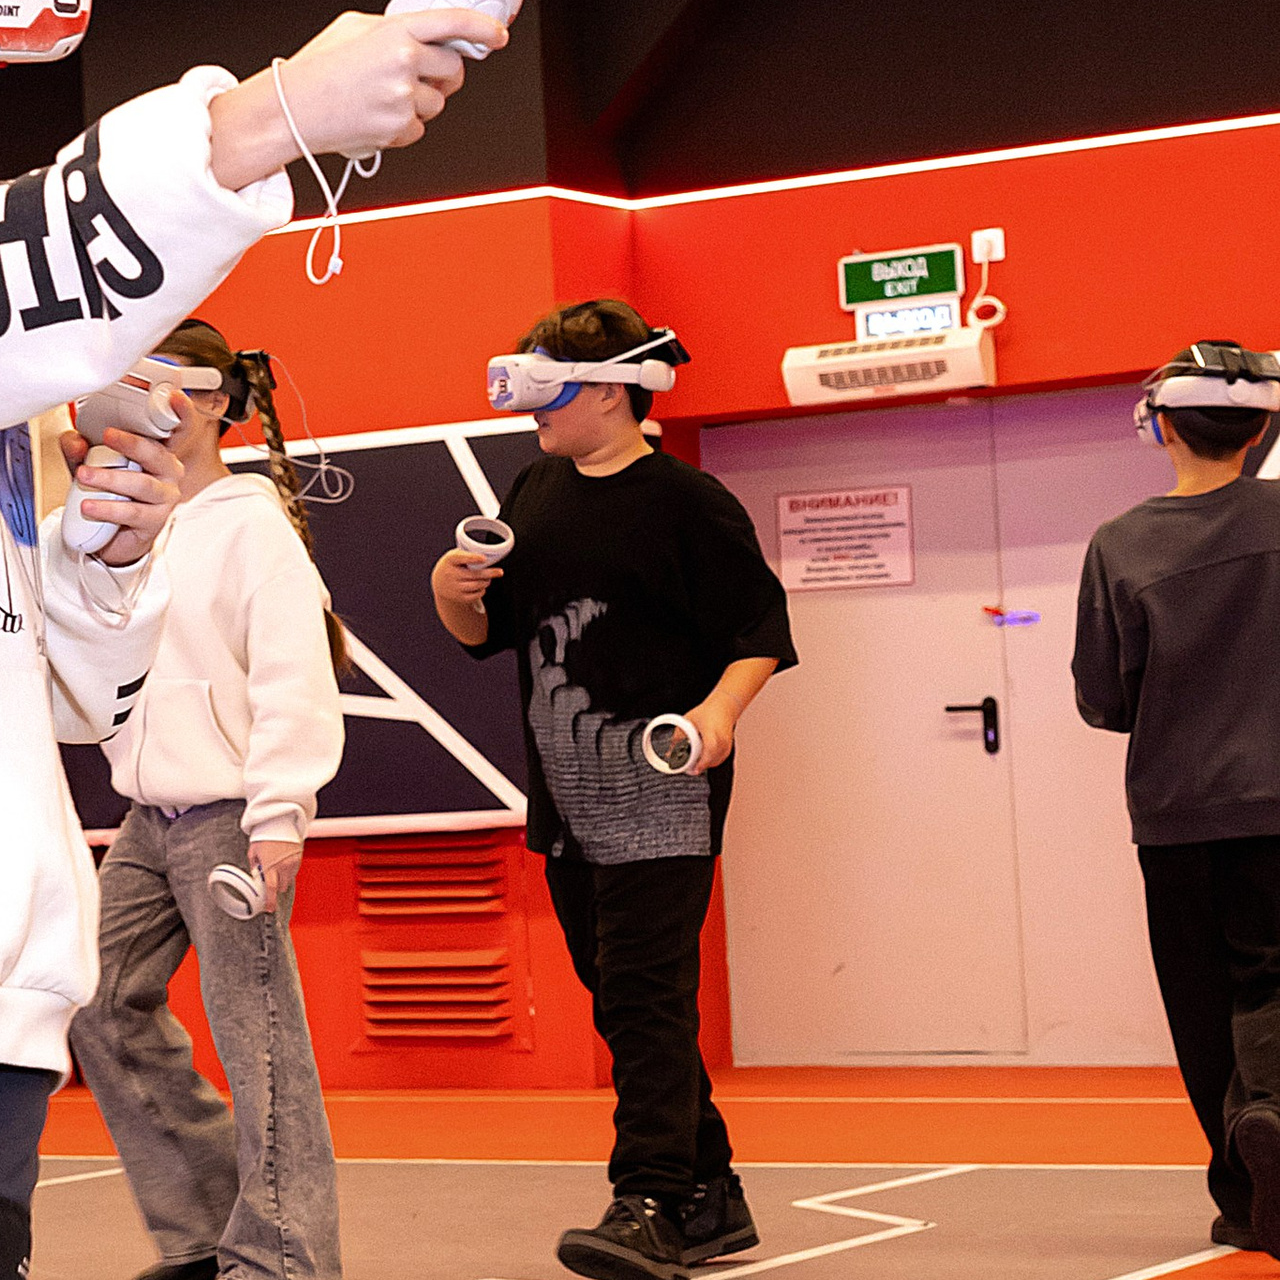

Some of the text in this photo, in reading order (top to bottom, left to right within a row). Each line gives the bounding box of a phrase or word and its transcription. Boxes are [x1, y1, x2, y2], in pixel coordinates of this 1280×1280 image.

[872, 256, 929, 282] ВЫХОД
[884, 277, 919, 297] EXIT
[788, 492, 898, 513] ВНИМАНИЕ!
